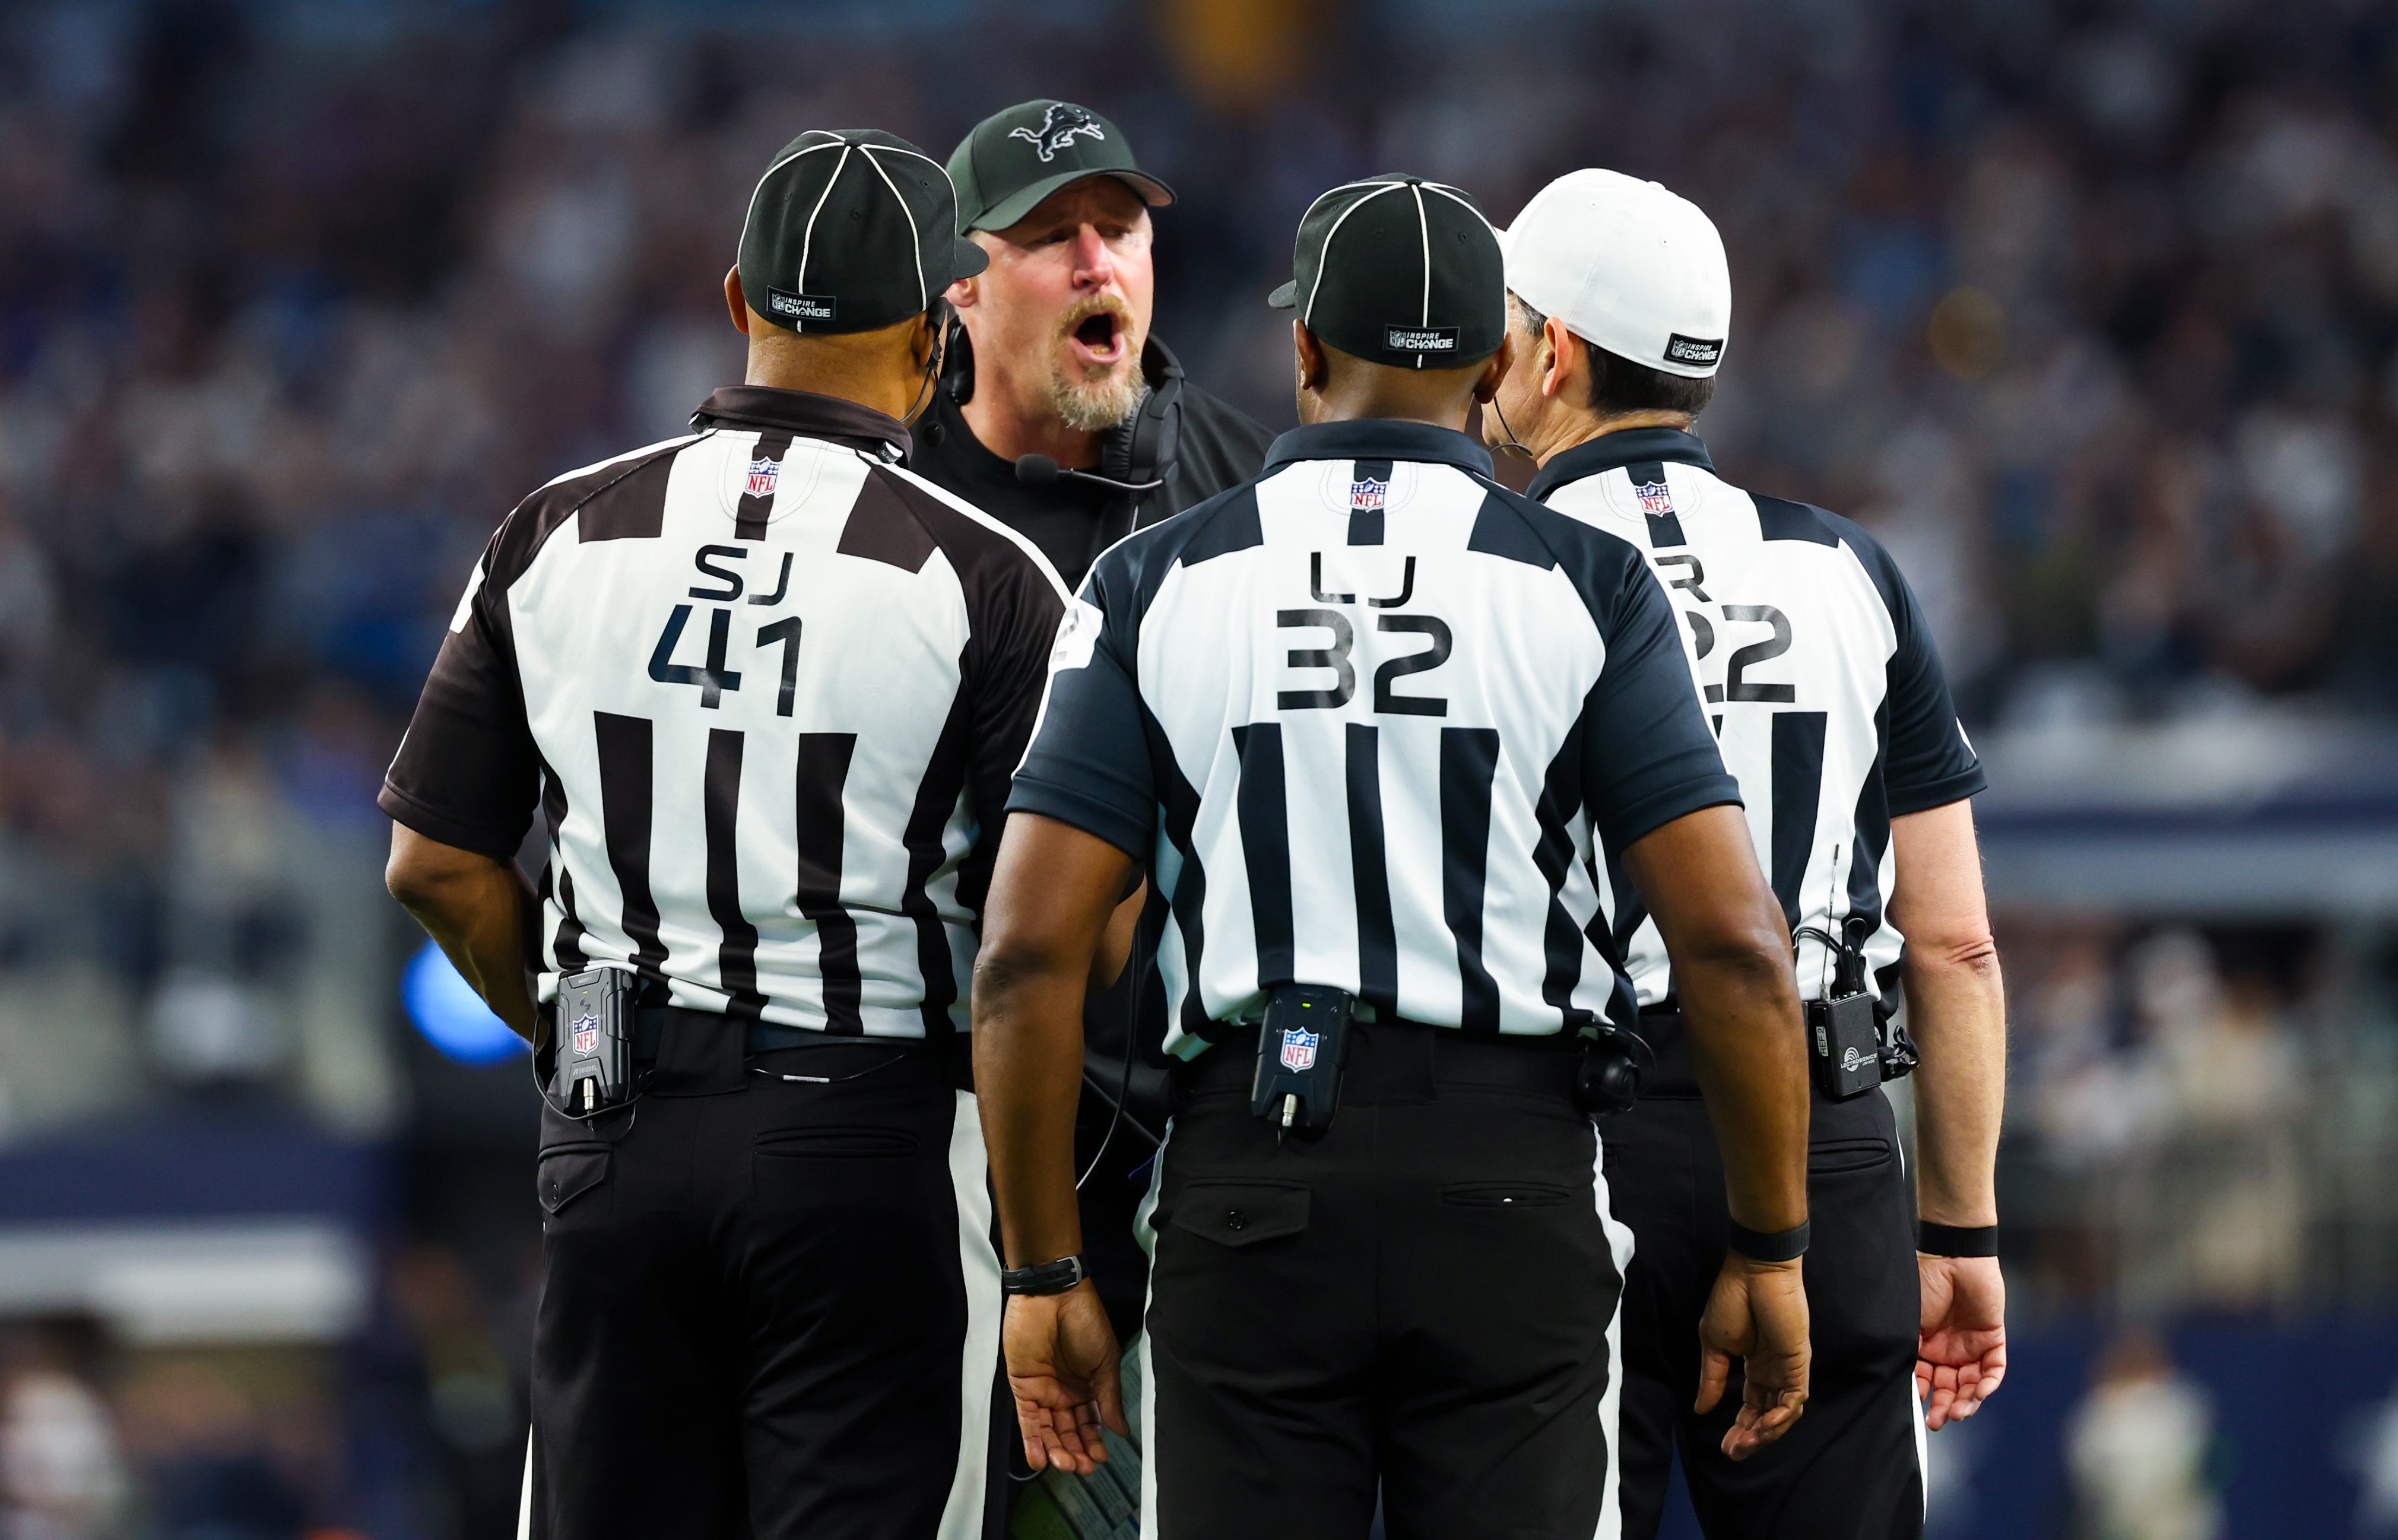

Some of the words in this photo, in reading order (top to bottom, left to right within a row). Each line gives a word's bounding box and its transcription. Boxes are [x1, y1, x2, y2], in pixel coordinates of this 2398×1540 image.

[785, 297, 816, 307] INSPIRE
[785, 303, 830, 317] CHANGE
[1406, 338, 1453, 349] CHANGE
[1685, 350, 1718, 360] CHANGE
[747, 475, 773, 493] NFL
[1354, 493, 1381, 507] NFL
[1641, 496, 1670, 511] NFL
[689, 544, 794, 606] SJ
[1311, 551, 1416, 608] LJ
[1654, 554, 1712, 602] R
[648, 604, 802, 717] 41
[1277, 609, 1452, 717] 32
[576, 1031, 595, 1050] NFL
[1818, 1036, 1827, 1054] REF
[1286, 1046, 1311, 1065] NFL
